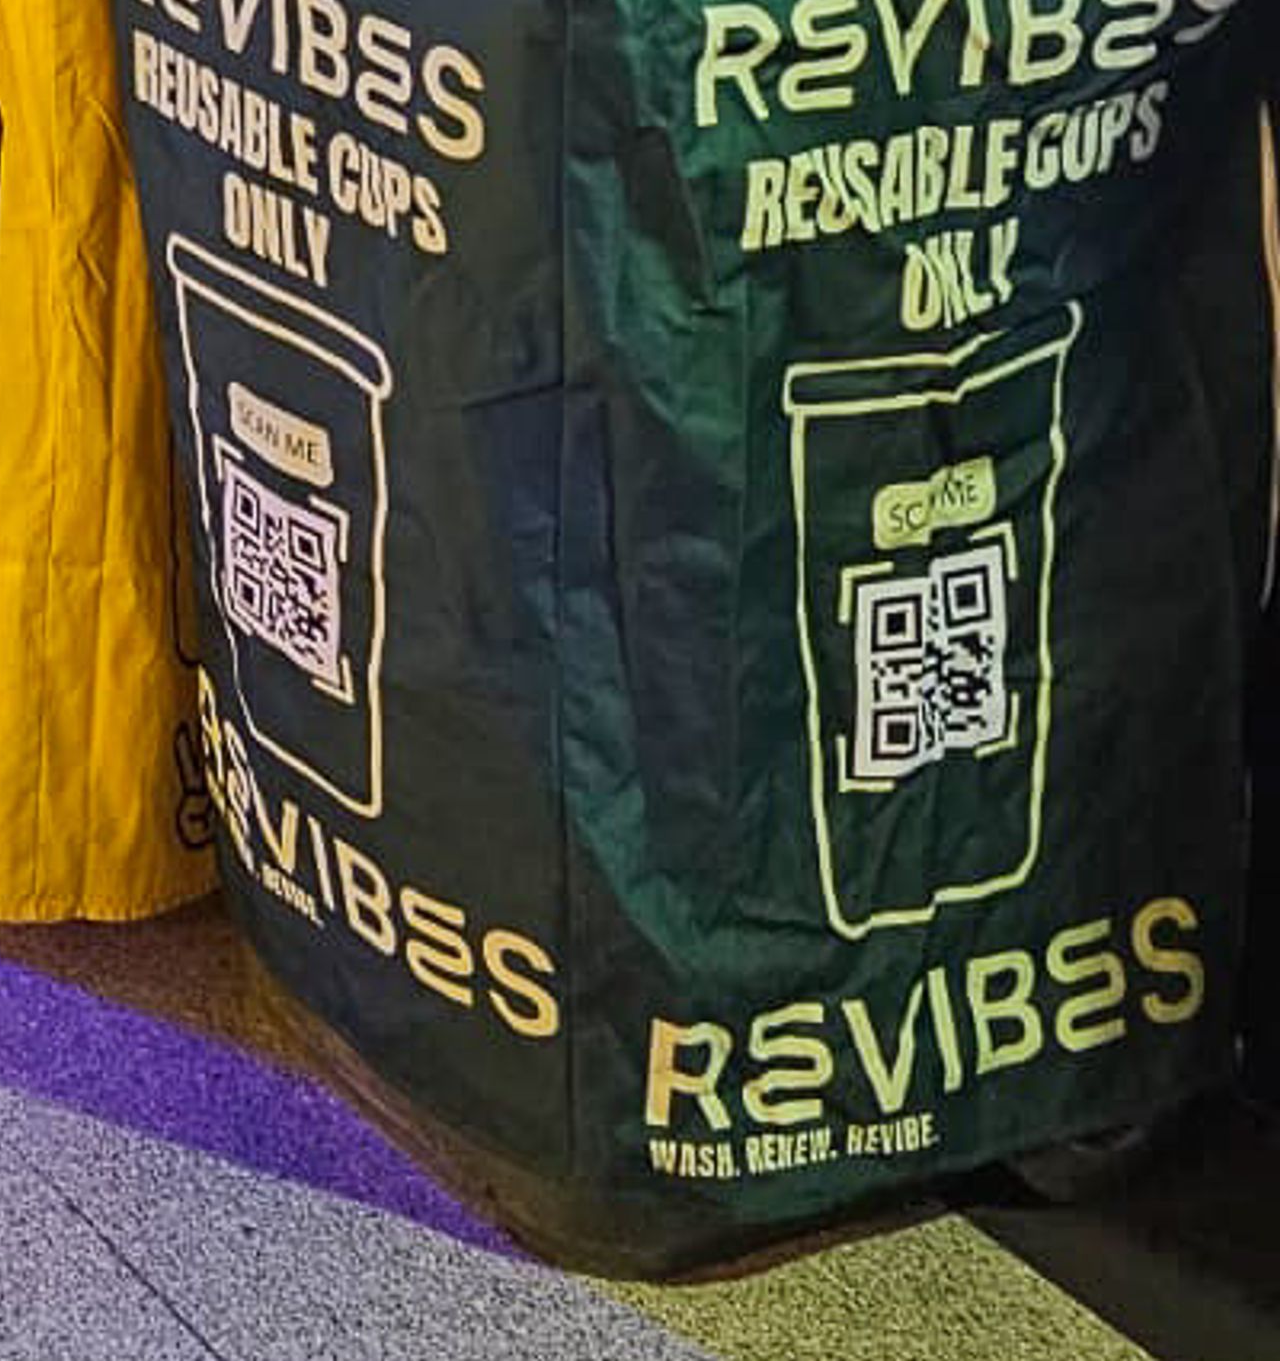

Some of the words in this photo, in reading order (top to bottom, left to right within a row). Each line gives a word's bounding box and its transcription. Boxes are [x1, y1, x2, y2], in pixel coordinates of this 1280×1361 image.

[133, 29, 319, 197] REUSABLE
[327, 134, 447, 256] CUPS
[741, 118, 1021, 251] REUSABLE
[1024, 79, 1168, 192] CUPS
[223, 172, 331, 288] ONLY
[900, 215, 1021, 330] ONLY
[285, 432, 322, 466] ME
[649, 1138, 742, 1180] WASH.
[745, 1126, 838, 1175] RENEW.
